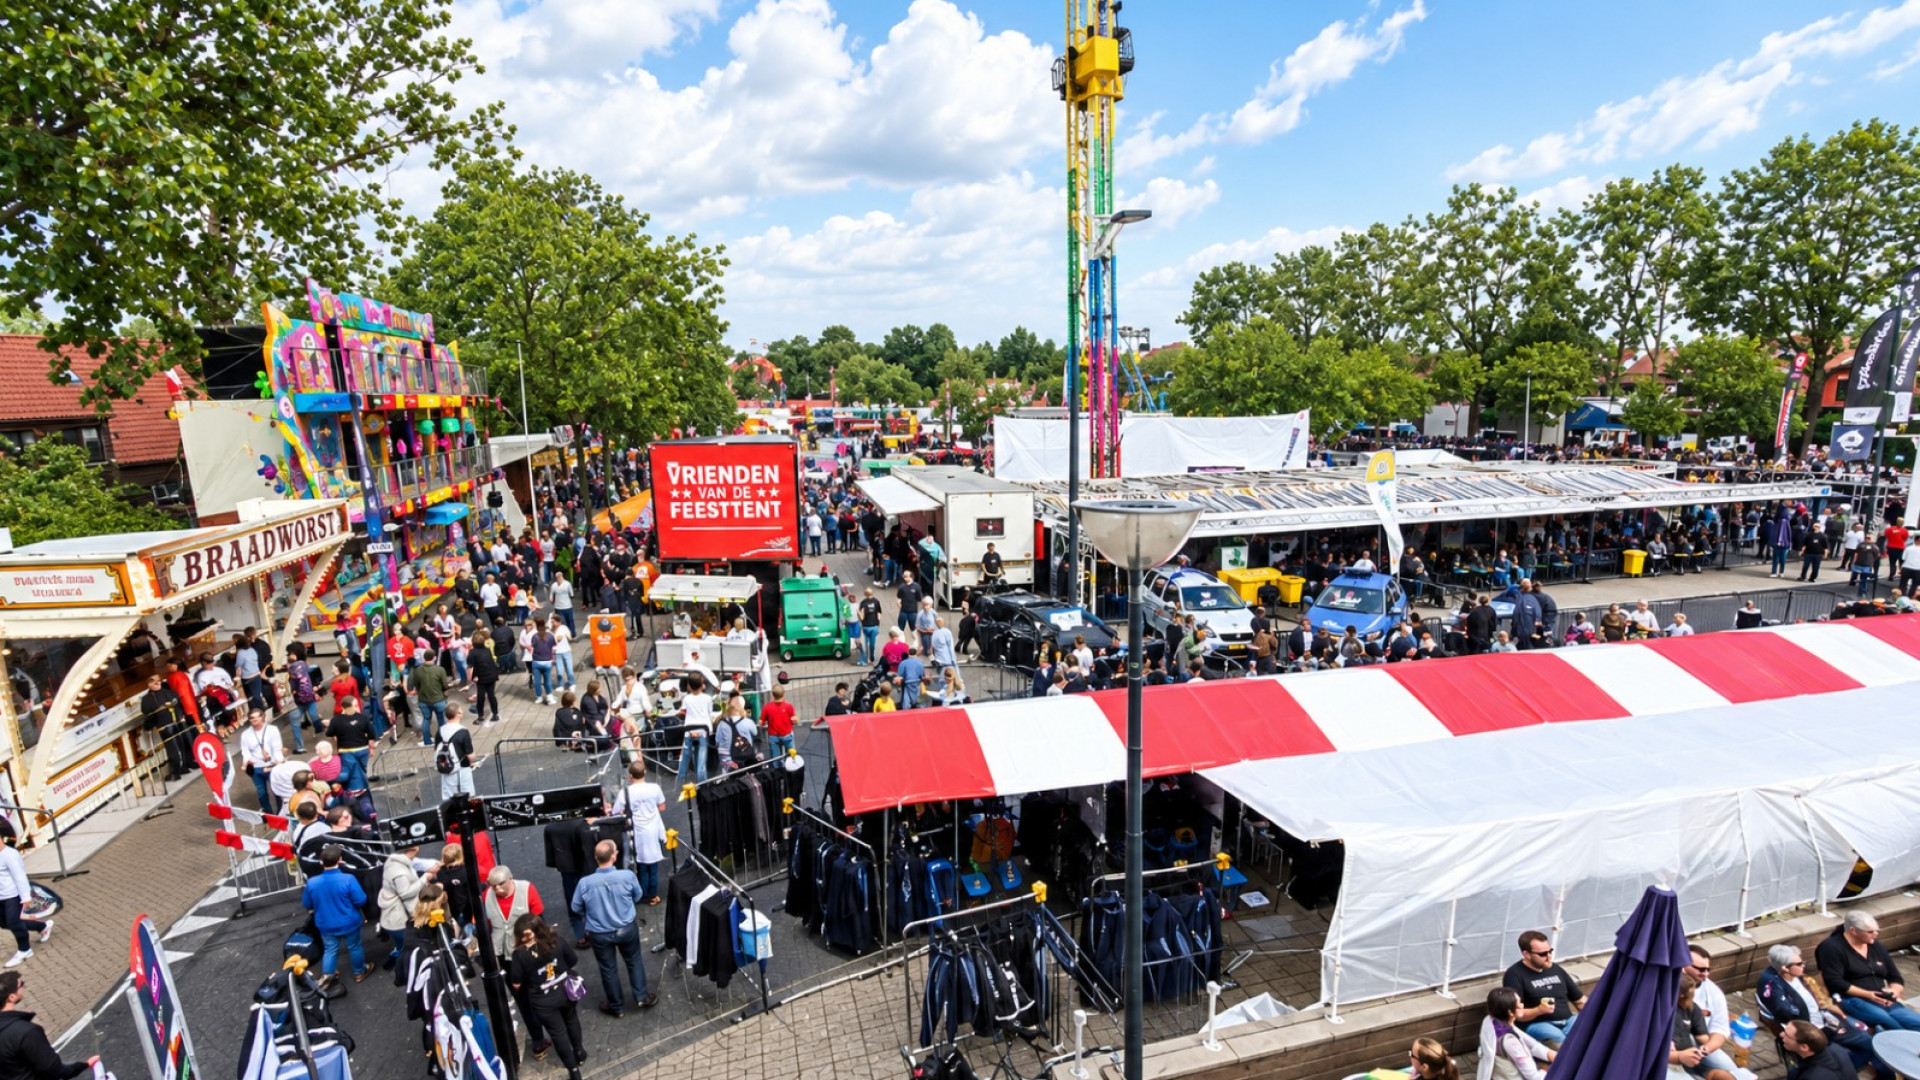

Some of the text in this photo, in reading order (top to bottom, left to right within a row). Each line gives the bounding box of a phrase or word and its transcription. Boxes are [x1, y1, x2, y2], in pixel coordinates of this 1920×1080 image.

[667, 462, 780, 485] VRIENDEN
[698, 486, 751, 499] VAN DE
[670, 500, 781, 519] FEESTTENT
[183, 511, 336, 587] BRAADWORST
